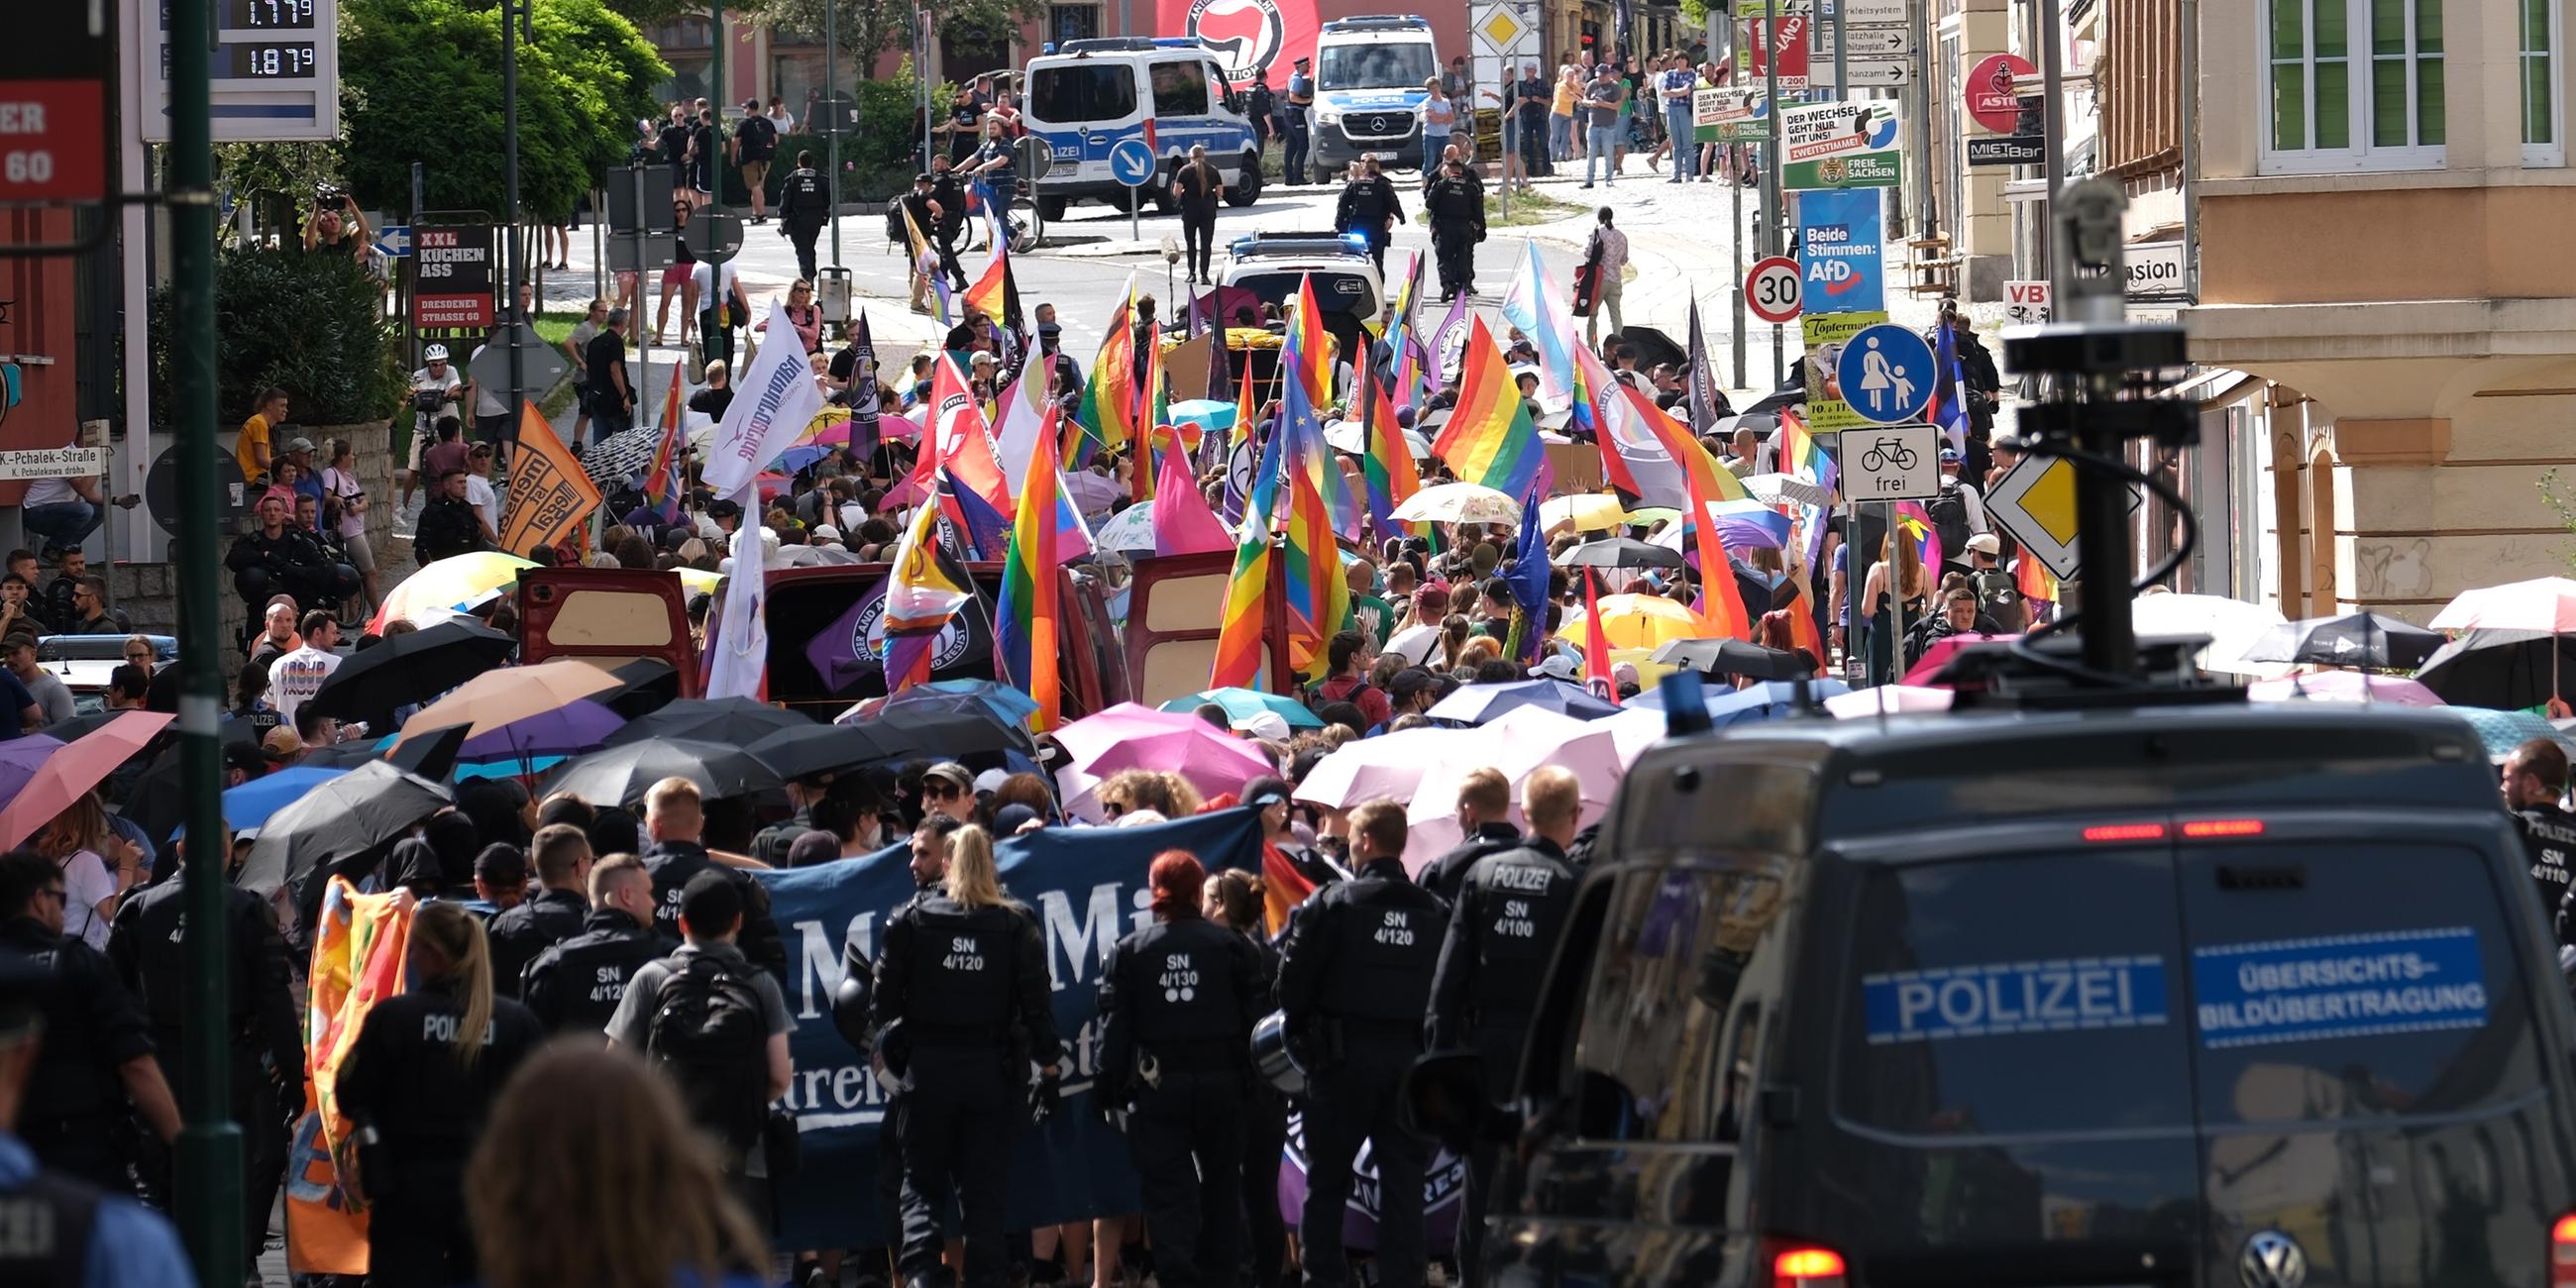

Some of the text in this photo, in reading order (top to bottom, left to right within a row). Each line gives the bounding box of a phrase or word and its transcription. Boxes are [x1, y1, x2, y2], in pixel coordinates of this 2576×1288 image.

[250, 49, 313, 74] 1.879
[1225, 64, 1259, 79] KTION
[1712, 90, 1747, 99] WECHSEL
[1787, 106, 1862, 125] DER WECHSEL
[1788, 121, 1836, 135] GEHT NUR
[1789, 132, 1831, 146] MIT UNS!
[1052, 147, 1079, 158] LIZEI
[1791, 139, 1859, 160] ZWEITSTIMME!
[5, 152, 53, 182] 60
[1848, 159, 1877, 168] FREIE
[1848, 167, 1895, 178] SACHSEN
[421, 233, 457, 247] XXL
[1806, 228, 1848, 242] Beide
[420, 248, 485, 263] KÜCHEN
[1806, 243, 1877, 258] Stimmen:
[420, 264, 452, 277] ASS
[1808, 261, 1851, 281] AfD
[1760, 275, 1797, 305] 30
[421, 299, 478, 309] DRESDENER
[422, 312, 480, 322] STRASSE 60
[1876, 476, 1906, 491] frei
[858, 609, 876, 633] AND
[943, 629, 965, 661] RESIST
[2541, 848, 2565, 867] SN
[1492, 865, 1552, 891] POLIZEI
[2530, 864, 2570, 885] 4/110
[1506, 901, 1529, 917] SN
[1383, 912, 1407, 928] SN
[1494, 917, 1535, 938] 4/100
[952, 937, 975, 953] SN
[1374, 927, 1414, 947] 4/120
[942, 954, 985, 971] 4/120
[1166, 954, 1190, 970] SN
[596, 966, 620, 982] SN
[1158, 970, 1199, 988] 4/130
[1897, 968, 2133, 1030] POLIZEI
[2198, 982, 2487, 1031] BILDÜBERTRAGUNG
